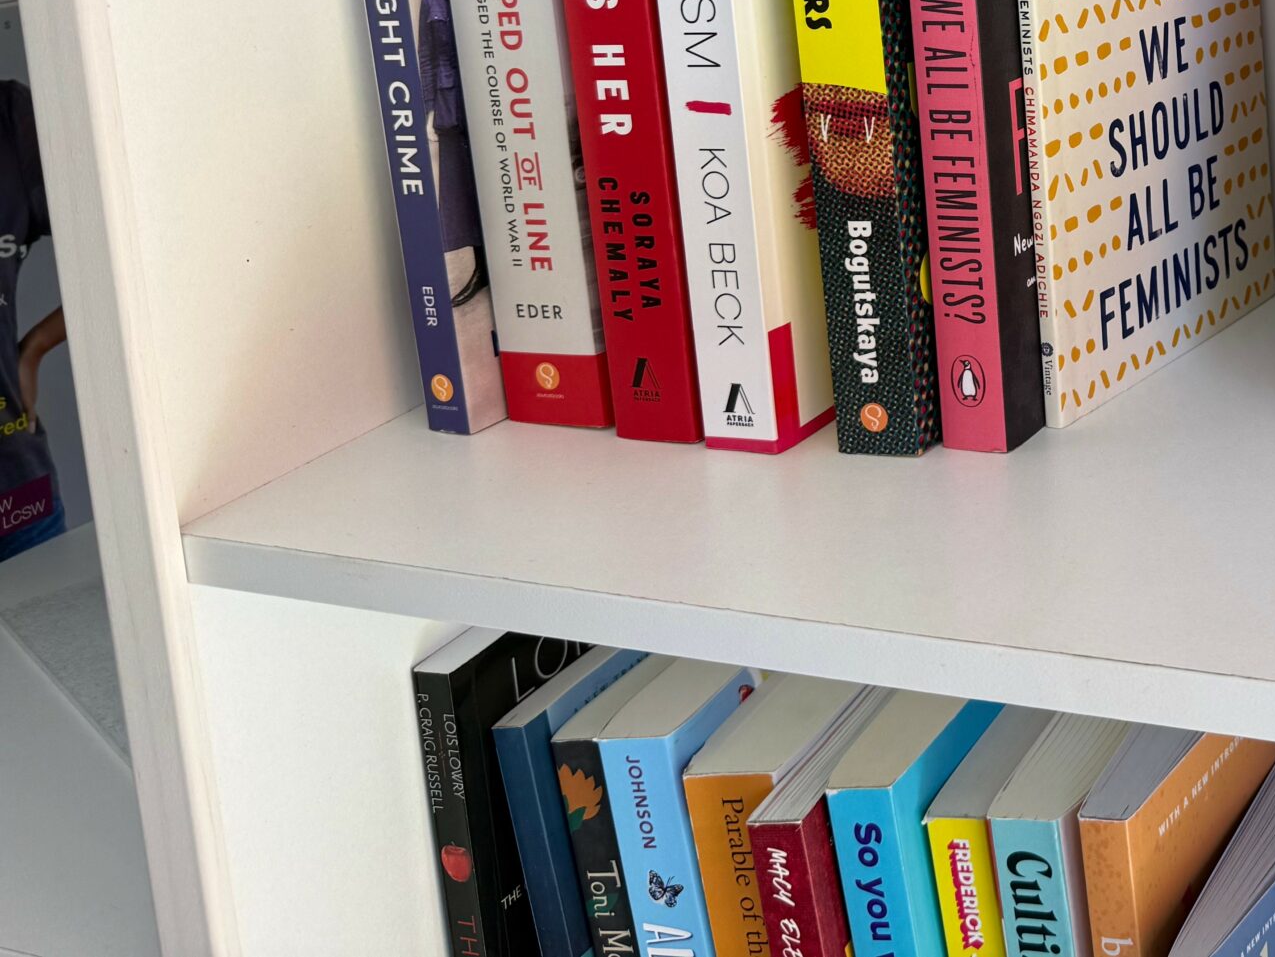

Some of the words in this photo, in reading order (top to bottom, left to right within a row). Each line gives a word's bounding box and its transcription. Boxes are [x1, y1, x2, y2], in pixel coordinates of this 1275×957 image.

[481, 31, 495, 60] THE
[923, 45, 969, 95] ALL
[1139, 16, 1189, 85] WE
[486, 64, 505, 126] COURSE
[506, 68, 536, 140] OUT
[591, 44, 634, 136] HER
[388, 81, 424, 195] CRIME
[496, 132, 508, 153] OF
[928, 109, 972, 142] BE
[1025, 86, 1041, 192] CHIMAMANDA
[1109, 80, 1225, 178] SHOULD
[499, 159, 515, 214] WORLD
[518, 155, 540, 190] OF
[699, 148, 733, 226] KOA
[1033, 200, 1044, 247] NGOZI
[1128, 179, 1178, 251] ALL
[1189, 155, 1220, 220] BE
[507, 219, 521, 256] WAR
[523, 202, 553, 272] LINE
[597, 176, 634, 322] CHEMALY
[630, 191, 662, 309] SORAYA
[932, 155, 986, 325] FEMINISTS?
[422, 286, 438, 327] EDER
[516, 303, 563, 319] EDER
[708, 241, 745, 346] BECK
[847, 220, 879, 384] Bogutskaya
[1036, 253, 1049, 319] ADICHIE
[1100, 218, 1249, 351] FEMINISTS
[1044, 360, 1053, 396] Vintage
[3, 499, 45, 529] LCSW
[417, 693, 429, 703] P.
[443, 713, 458, 743] LOIS
[419, 707, 436, 751] CRAIG
[425, 755, 444, 813] RUSSELL
[448, 749, 465, 800] LOWRY
[626, 755, 656, 849] JOHNSON
[1159, 805, 1180, 836] WITH
[1183, 796, 1189, 809] A
[1192, 771, 1208, 799] NEW
[722, 797, 755, 887] Parable
[740, 897, 766, 925] of
[854, 822, 882, 867] So
[500, 885, 522, 910] THE
[587, 860, 621, 918] Toni
[767, 847, 795, 906] MACY
[952, 839, 984, 946] FREDERICK
[856, 877, 892, 941] you
[1246, 931, 1261, 954] NEW
